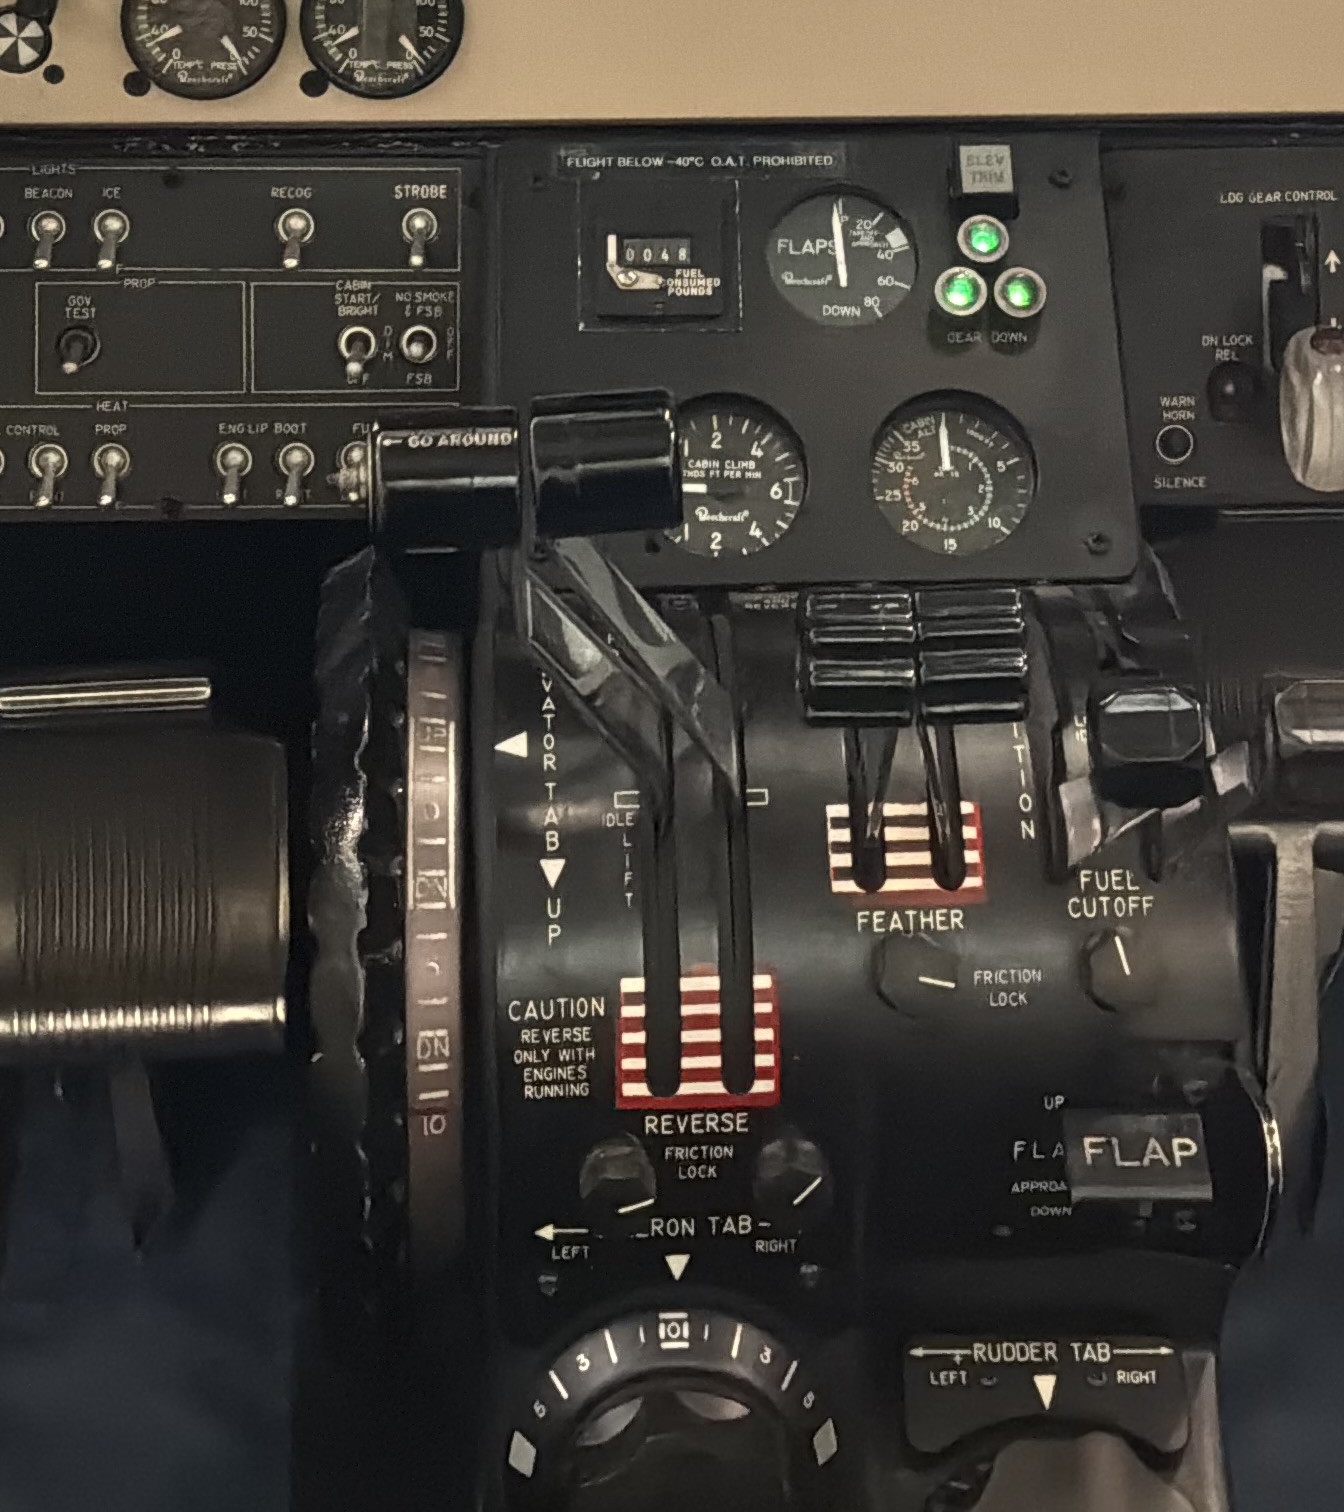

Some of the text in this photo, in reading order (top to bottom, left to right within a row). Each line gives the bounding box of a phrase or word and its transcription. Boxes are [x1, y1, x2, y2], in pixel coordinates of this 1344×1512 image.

[566, 156, 614, 168] FLIGHT
[617, 156, 663, 168] BELOW
[753, 154, 833, 167] PROHIBITED
[24, 188, 73, 199] BEACON
[271, 187, 312, 199] RECOG
[394, 185, 447, 200] STROBE
[1249, 191, 1281, 203] GEAR
[1285, 190, 1338, 202] CONTROL
[822, 304, 861, 318] DOWN
[408, 432, 513, 448] GO AROUND
[687, 460, 756, 469] CABIN CLIMB
[1153, 476, 1207, 488] SILENCE
[1080, 869, 1139, 891] FUEL
[1068, 896, 1154, 918] CUTOFF
[857, 909, 964, 933] FEATHER
[973, 969, 1042, 986] FRICTION
[989, 992, 1027, 1007] LOCK
[508, 997, 606, 1021] CAUTION
[521, 1027, 591, 1044] REVERSE
[513, 1047, 595, 1064] ONLY WITH
[524, 1066, 587, 1082] ENGINES
[524, 1083, 590, 1098] RUNNING
[645, 1113, 749, 1135] REVERSE
[1084, 1138, 1198, 1168] FLAP
[708, 1217, 753, 1235] TAB
[552, 1245, 590, 1261] LEFT
[972, 1343, 1111, 1362] RUDDER TAB
[1115, 1369, 1157, 1385] RIGHT
